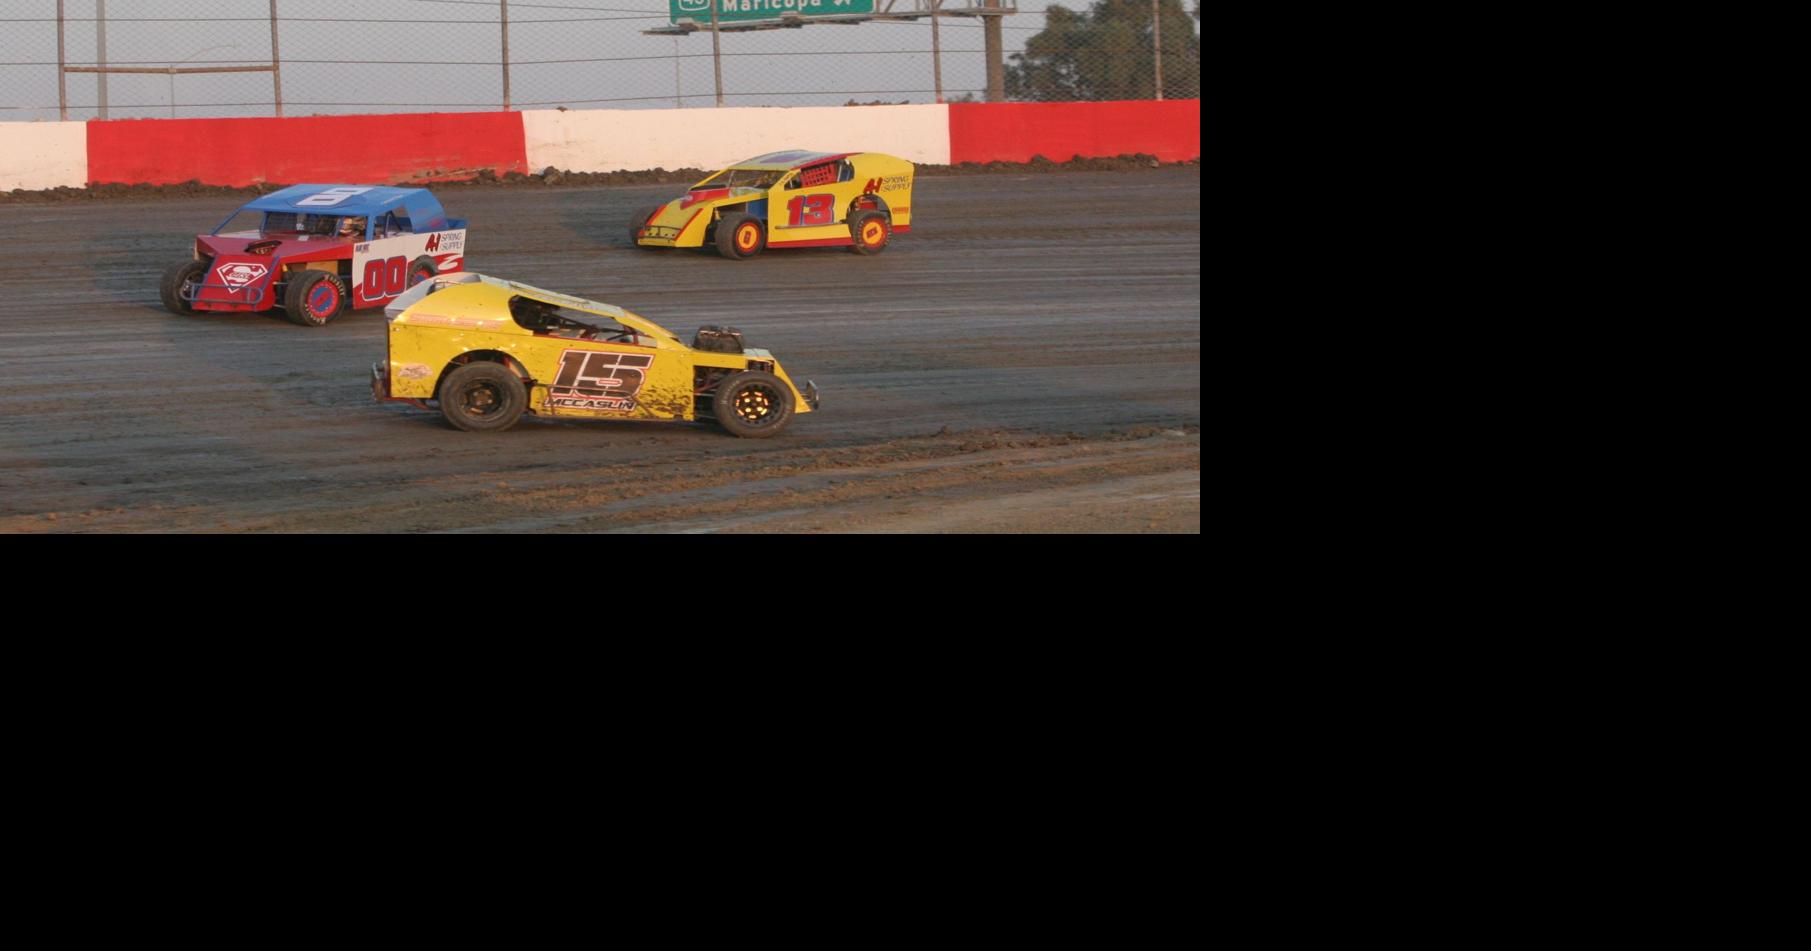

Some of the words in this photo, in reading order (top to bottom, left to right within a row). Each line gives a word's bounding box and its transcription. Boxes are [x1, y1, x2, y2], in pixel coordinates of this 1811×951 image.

[787, 194, 836, 225] 13
[363, 256, 408, 301] 00
[550, 349, 655, 399] 15
[546, 399, 635, 411] MCCASLIN
